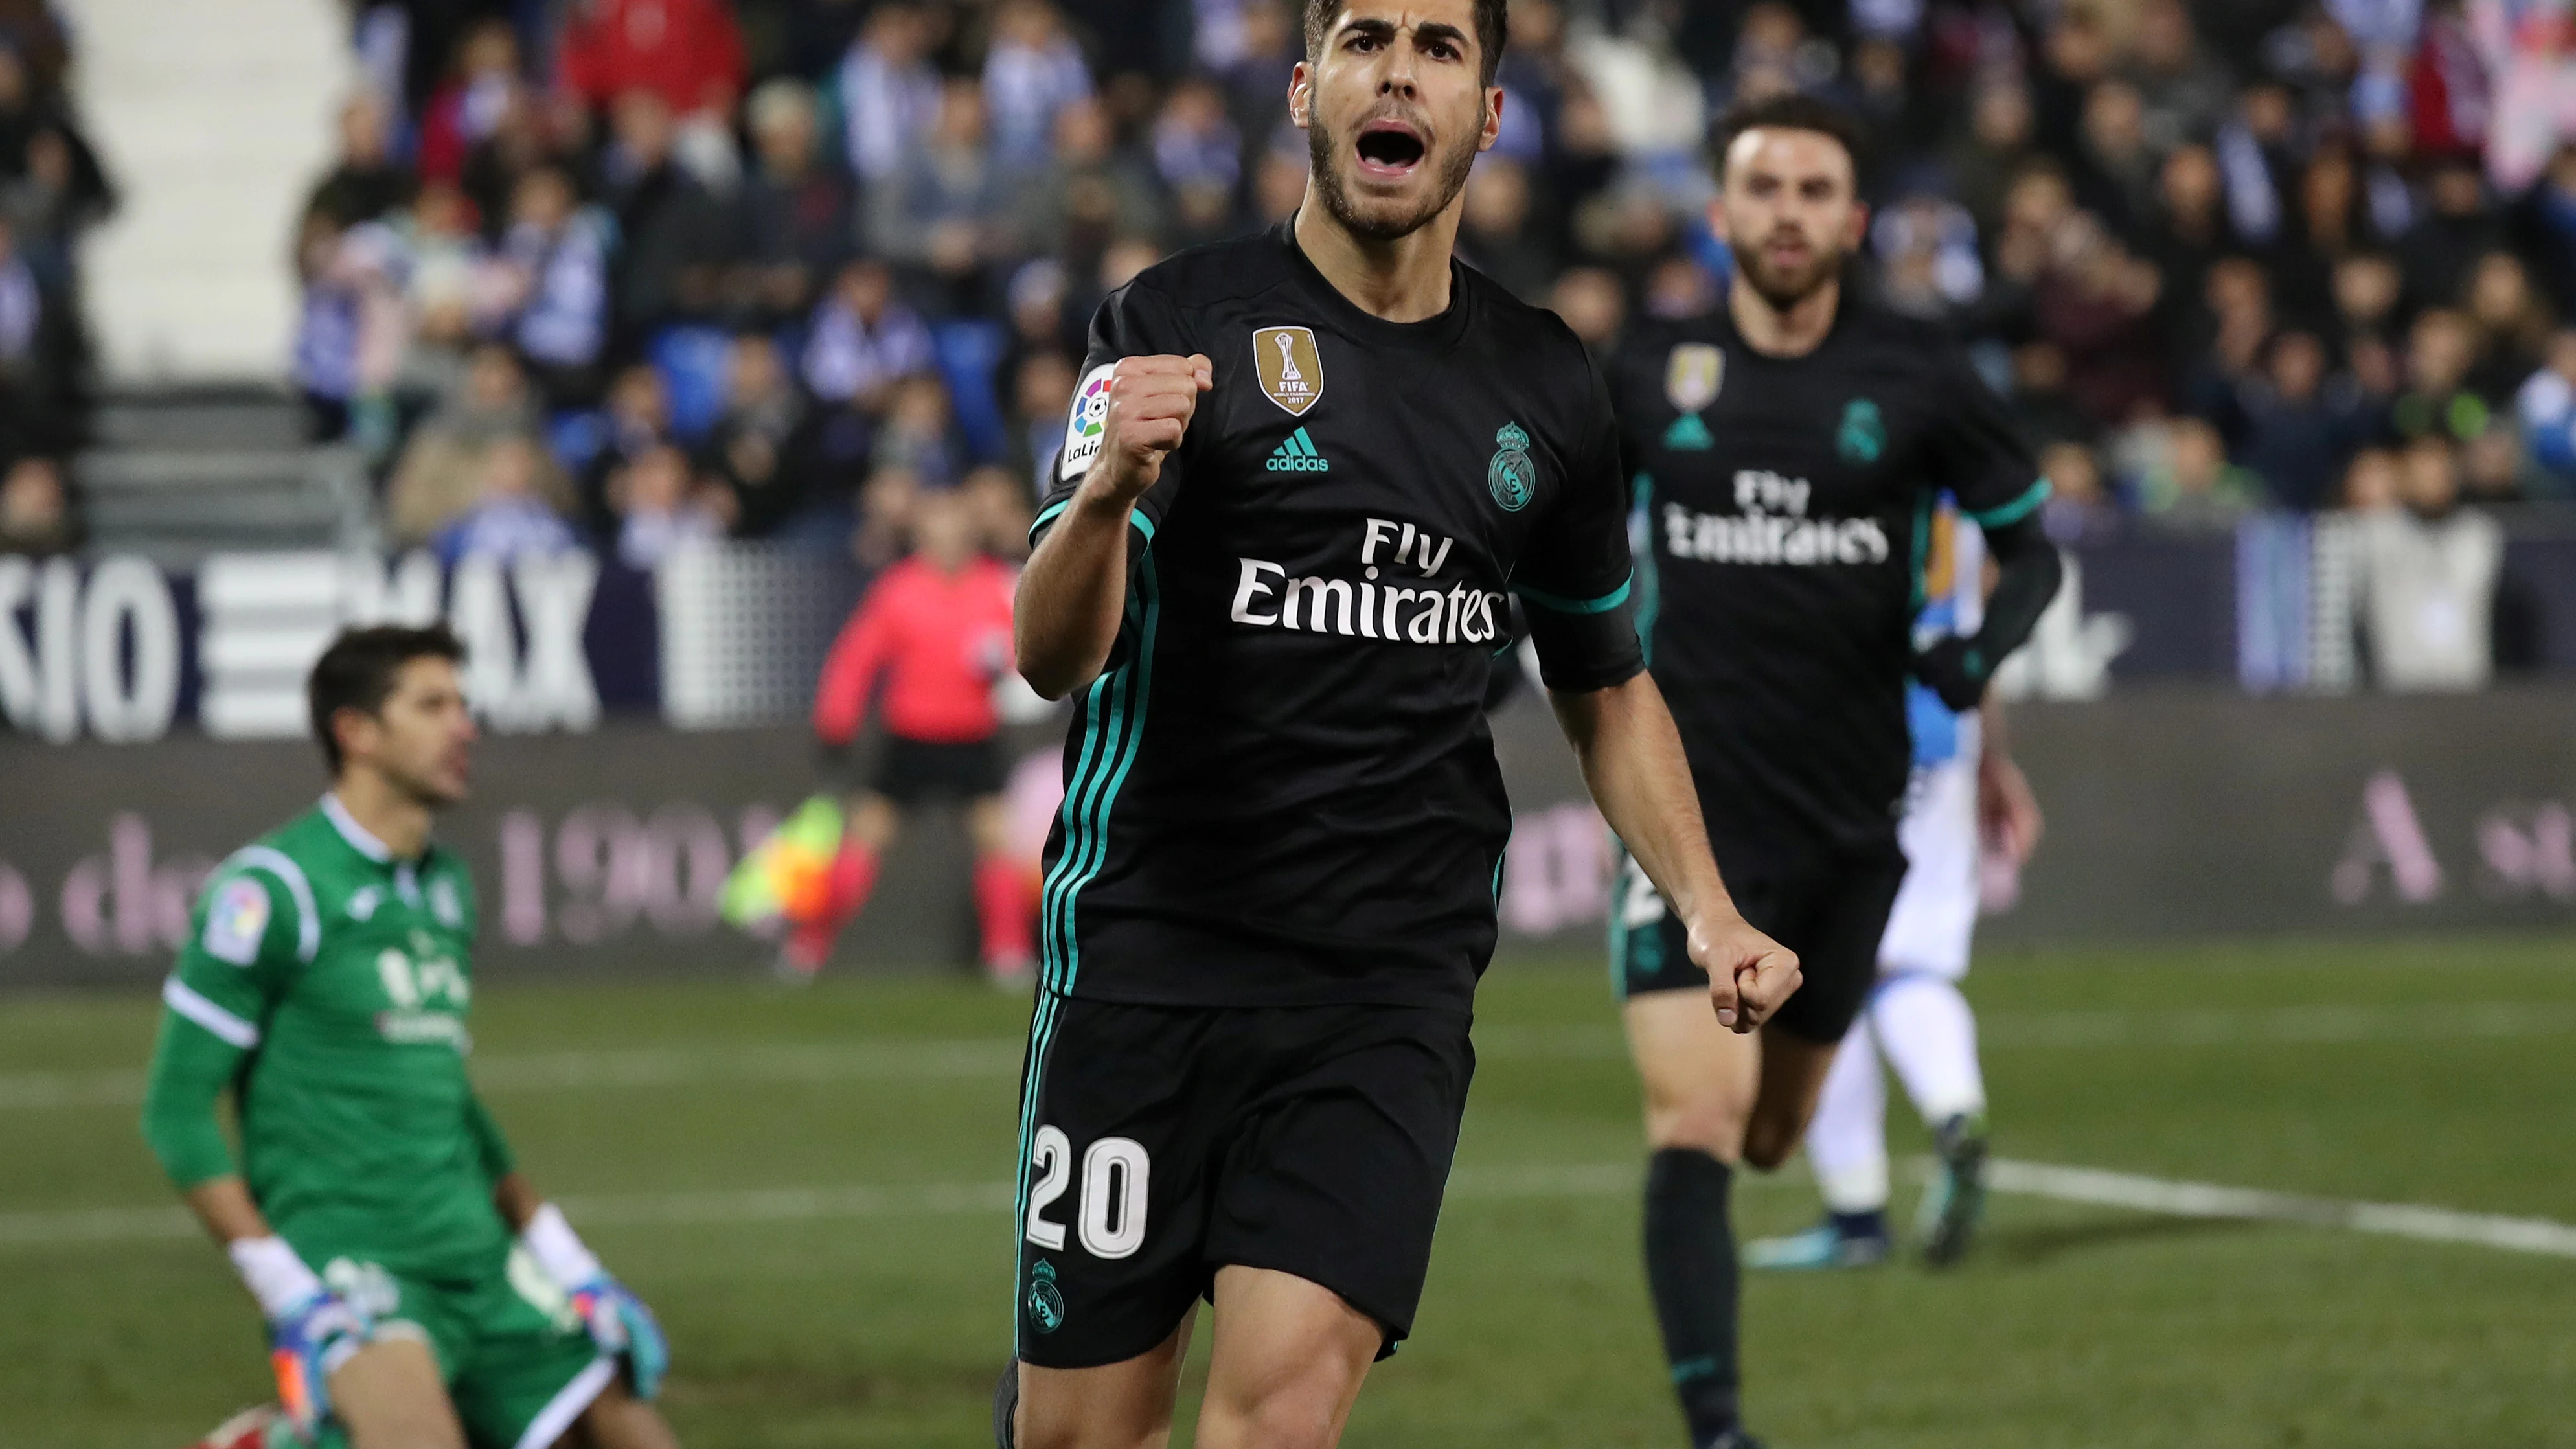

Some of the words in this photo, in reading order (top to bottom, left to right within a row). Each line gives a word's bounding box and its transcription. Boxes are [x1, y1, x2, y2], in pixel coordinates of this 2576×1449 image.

[1279, 381, 1308, 392] FIFA
[1266, 454, 1329, 472] adidas
[1361, 518, 1453, 578] Fly
[1231, 557, 1505, 644] Emirates
[500, 800, 787, 946] 190
[1026, 1124, 1150, 1259] 20
